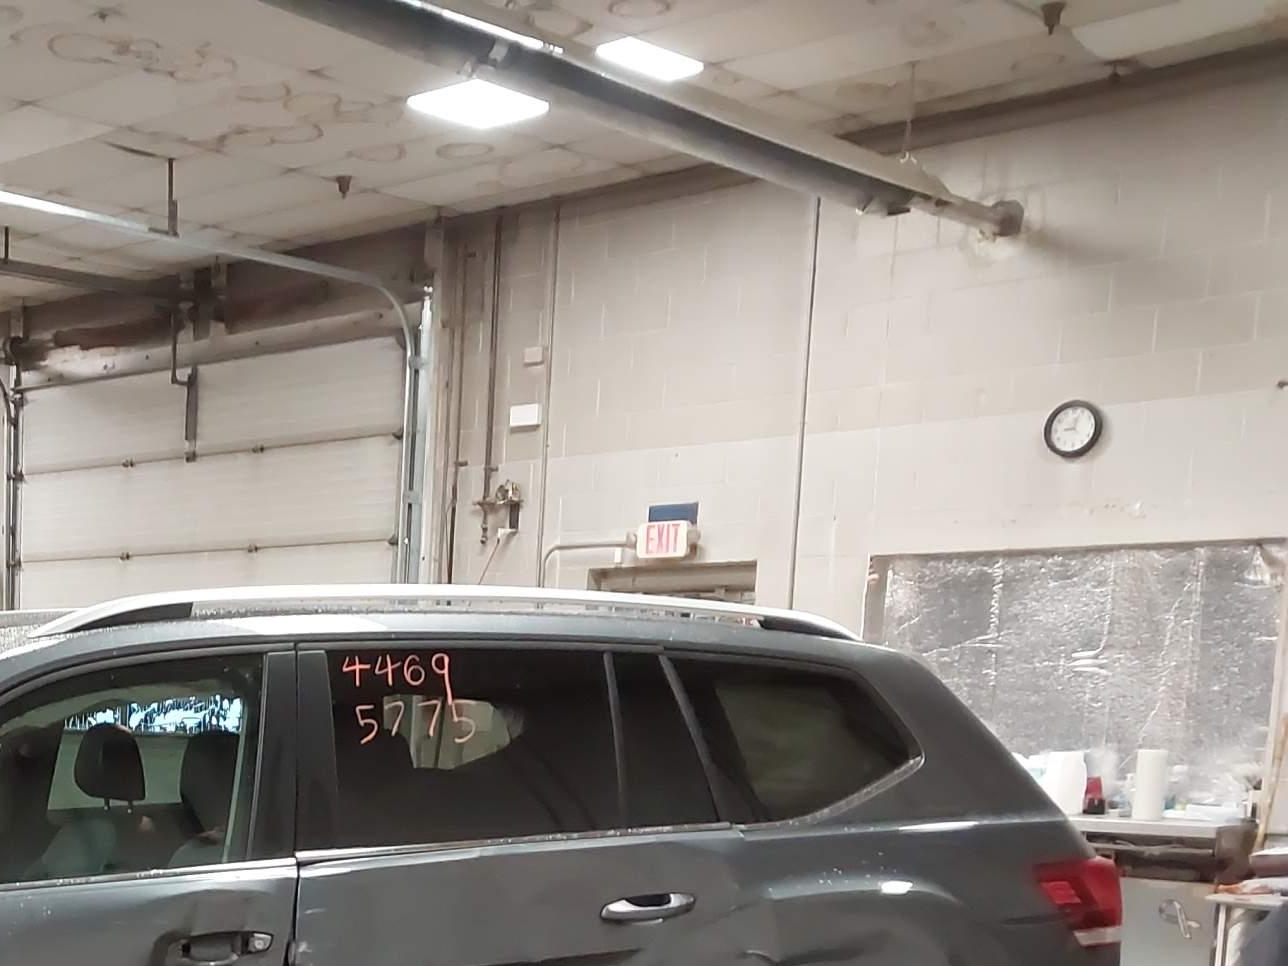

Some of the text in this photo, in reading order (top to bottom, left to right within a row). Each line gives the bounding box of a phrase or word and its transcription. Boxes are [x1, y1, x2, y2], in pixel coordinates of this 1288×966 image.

[645, 523, 681, 554] EXIT
[342, 652, 450, 705] 4469
[355, 698, 477, 744] 5775
